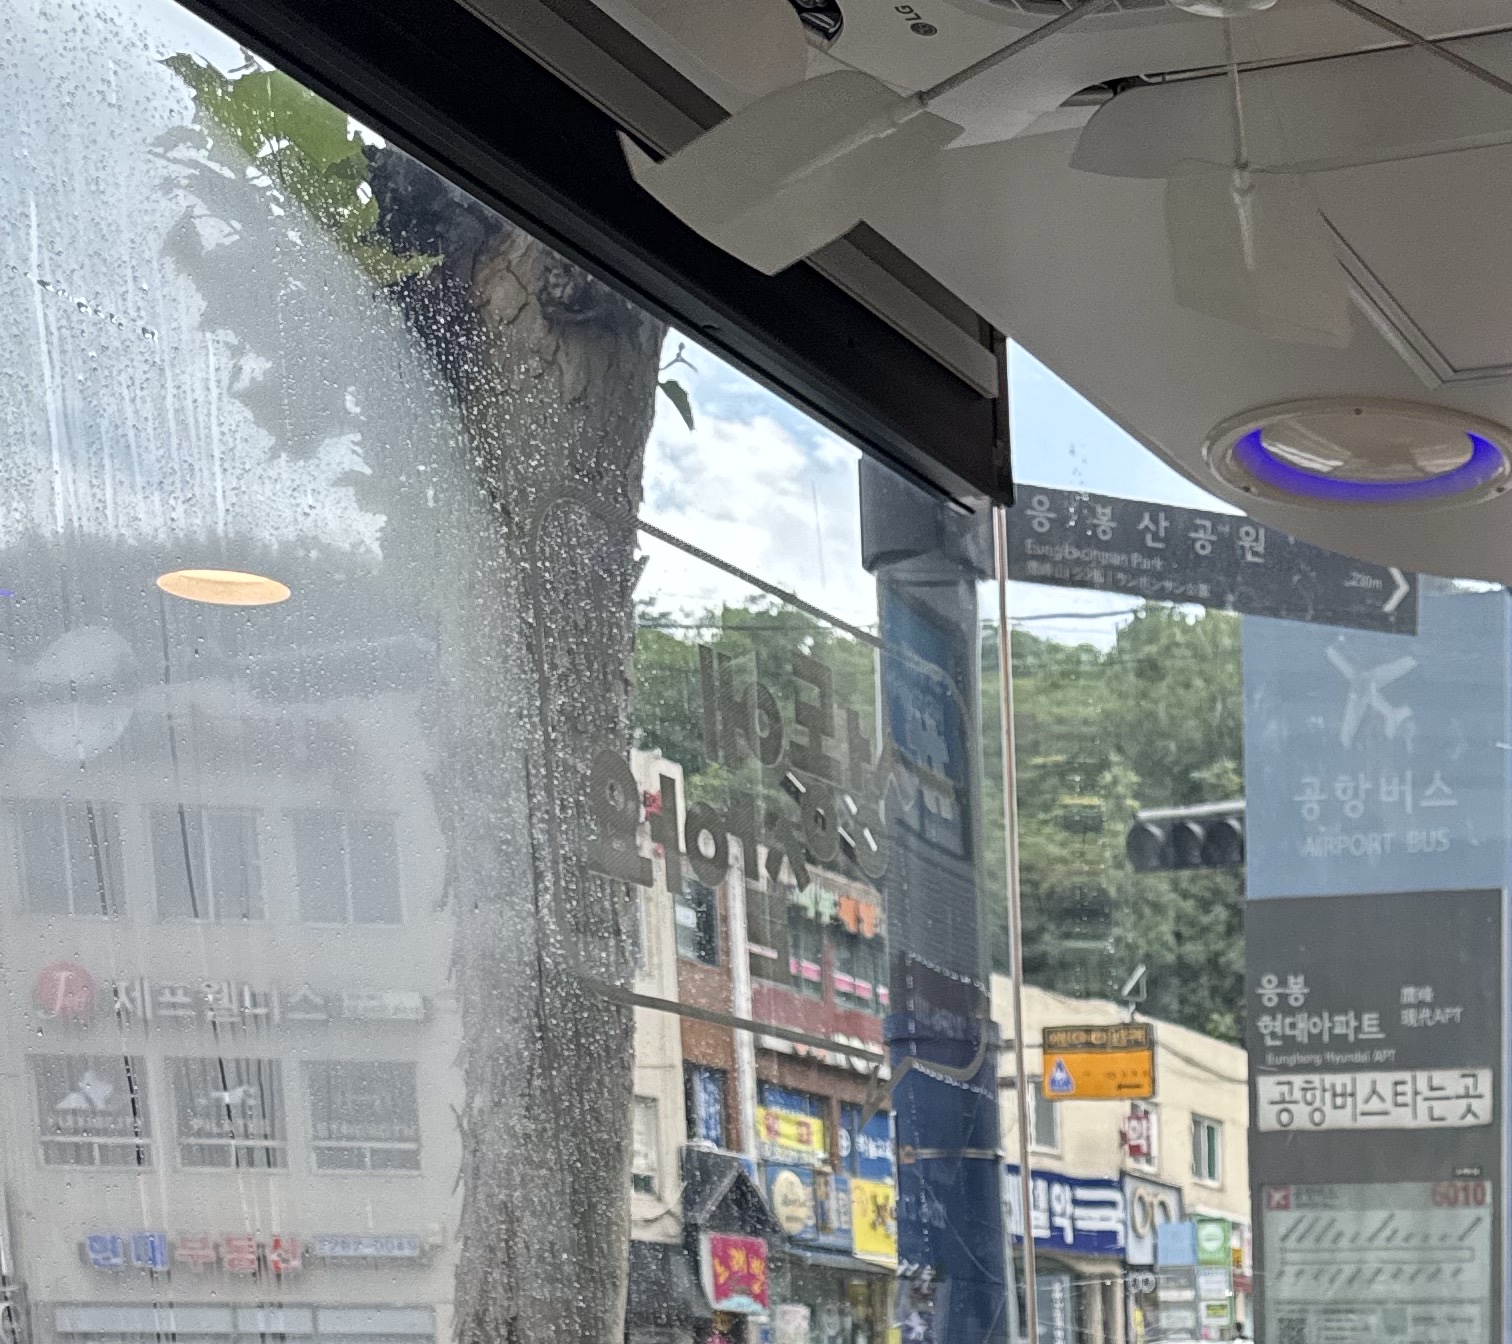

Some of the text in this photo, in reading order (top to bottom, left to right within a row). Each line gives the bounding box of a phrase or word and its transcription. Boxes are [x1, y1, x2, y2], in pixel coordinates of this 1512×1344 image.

[894, 5, 922, 21] LG
[1025, 494, 1266, 564] 응봉산공원
[1294, 770, 1458, 821] 공항버스
[1301, 830, 1450, 857] AIRPORT BUS
[1255, 974, 1310, 1008] 응봉
[1257, 1010, 1386, 1047] 현대아파트
[1268, 1073, 1485, 1128] 공항버스타는곳
